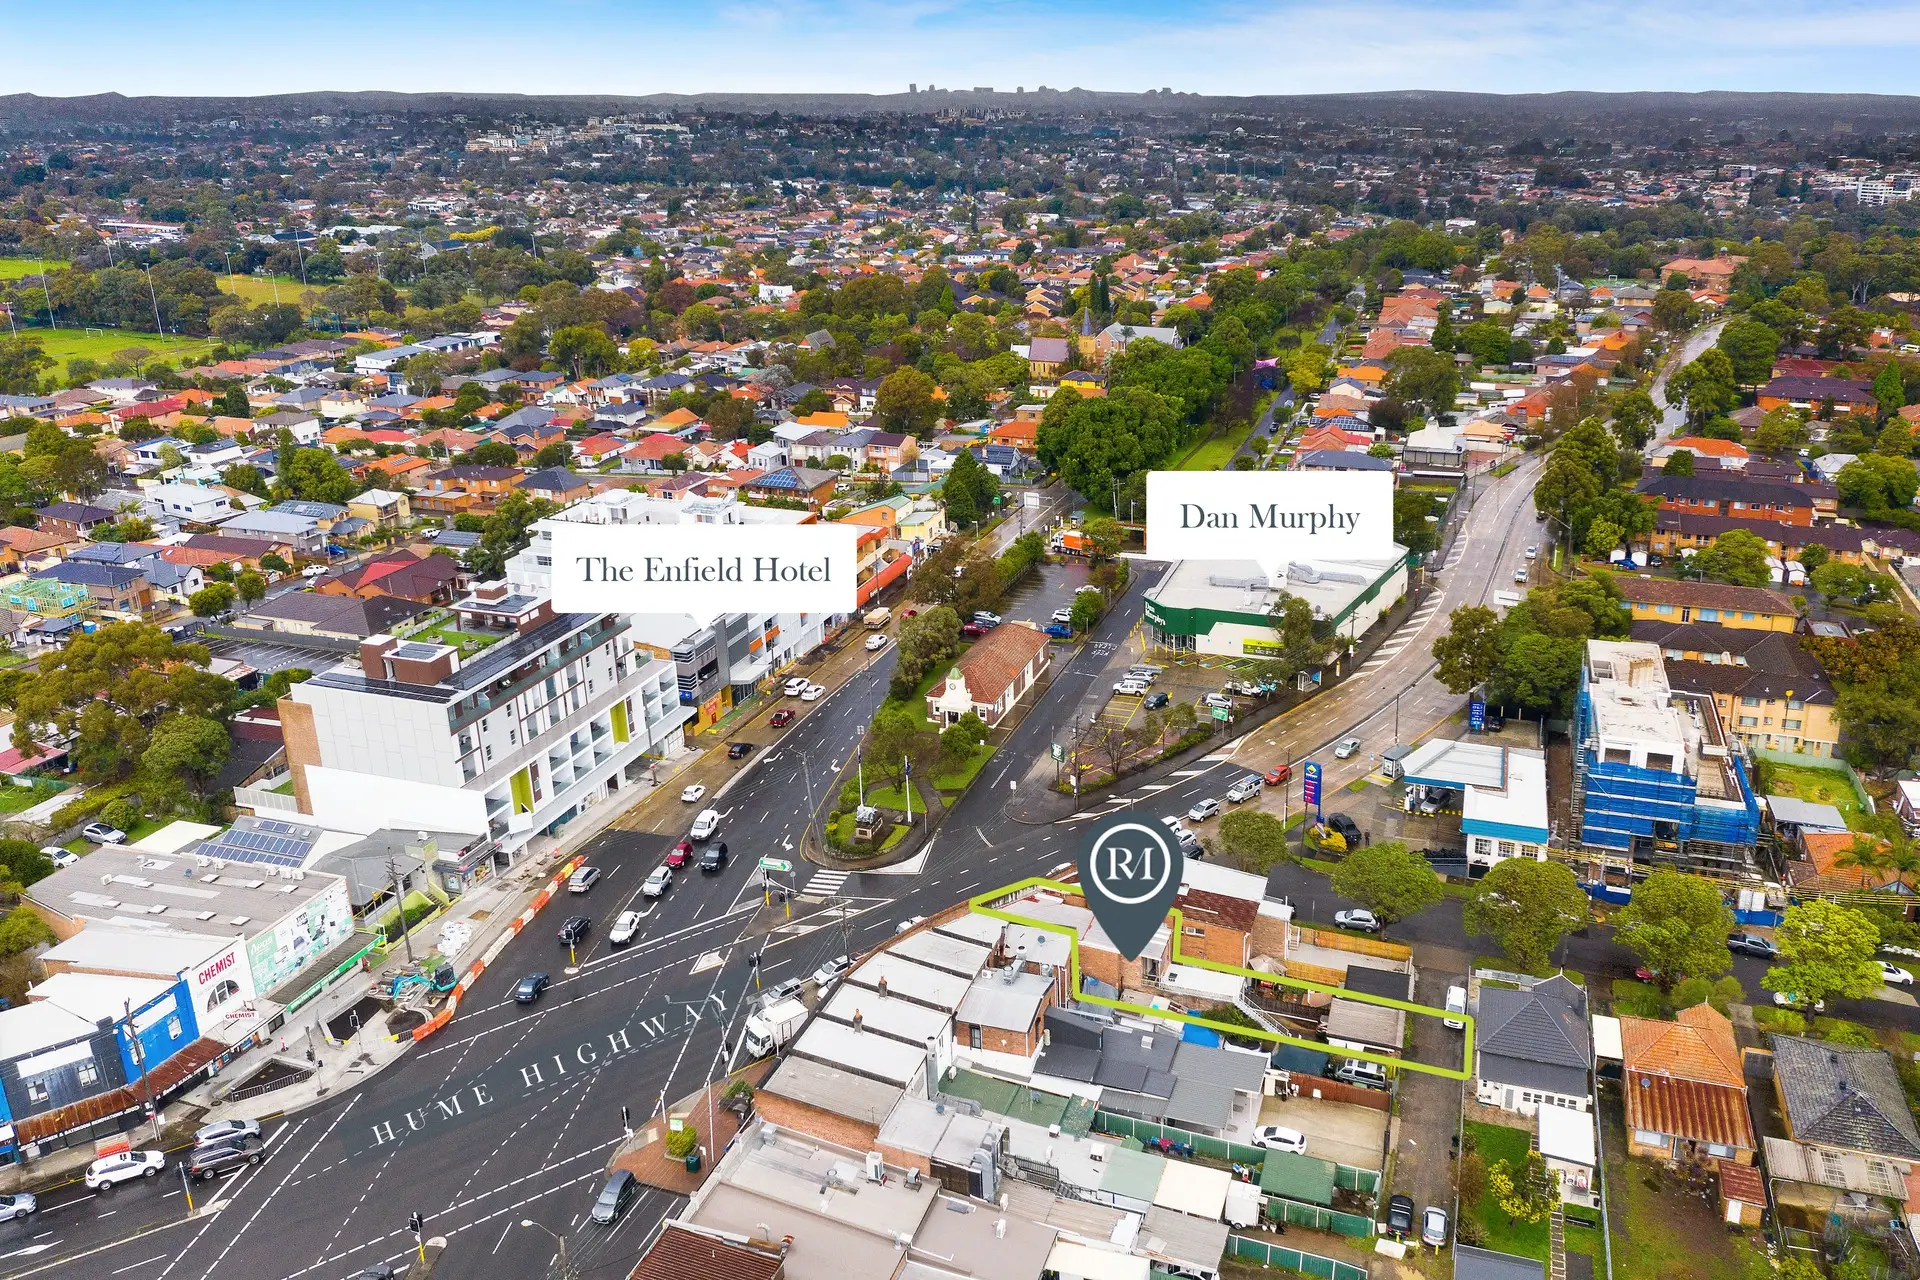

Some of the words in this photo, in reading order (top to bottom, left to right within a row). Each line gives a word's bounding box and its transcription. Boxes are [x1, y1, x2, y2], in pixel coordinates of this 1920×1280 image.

[1145, 600, 1155, 613] Dan
[1145, 608, 1166, 625] Murphy's
[198, 952, 236, 985] CHEMIST
